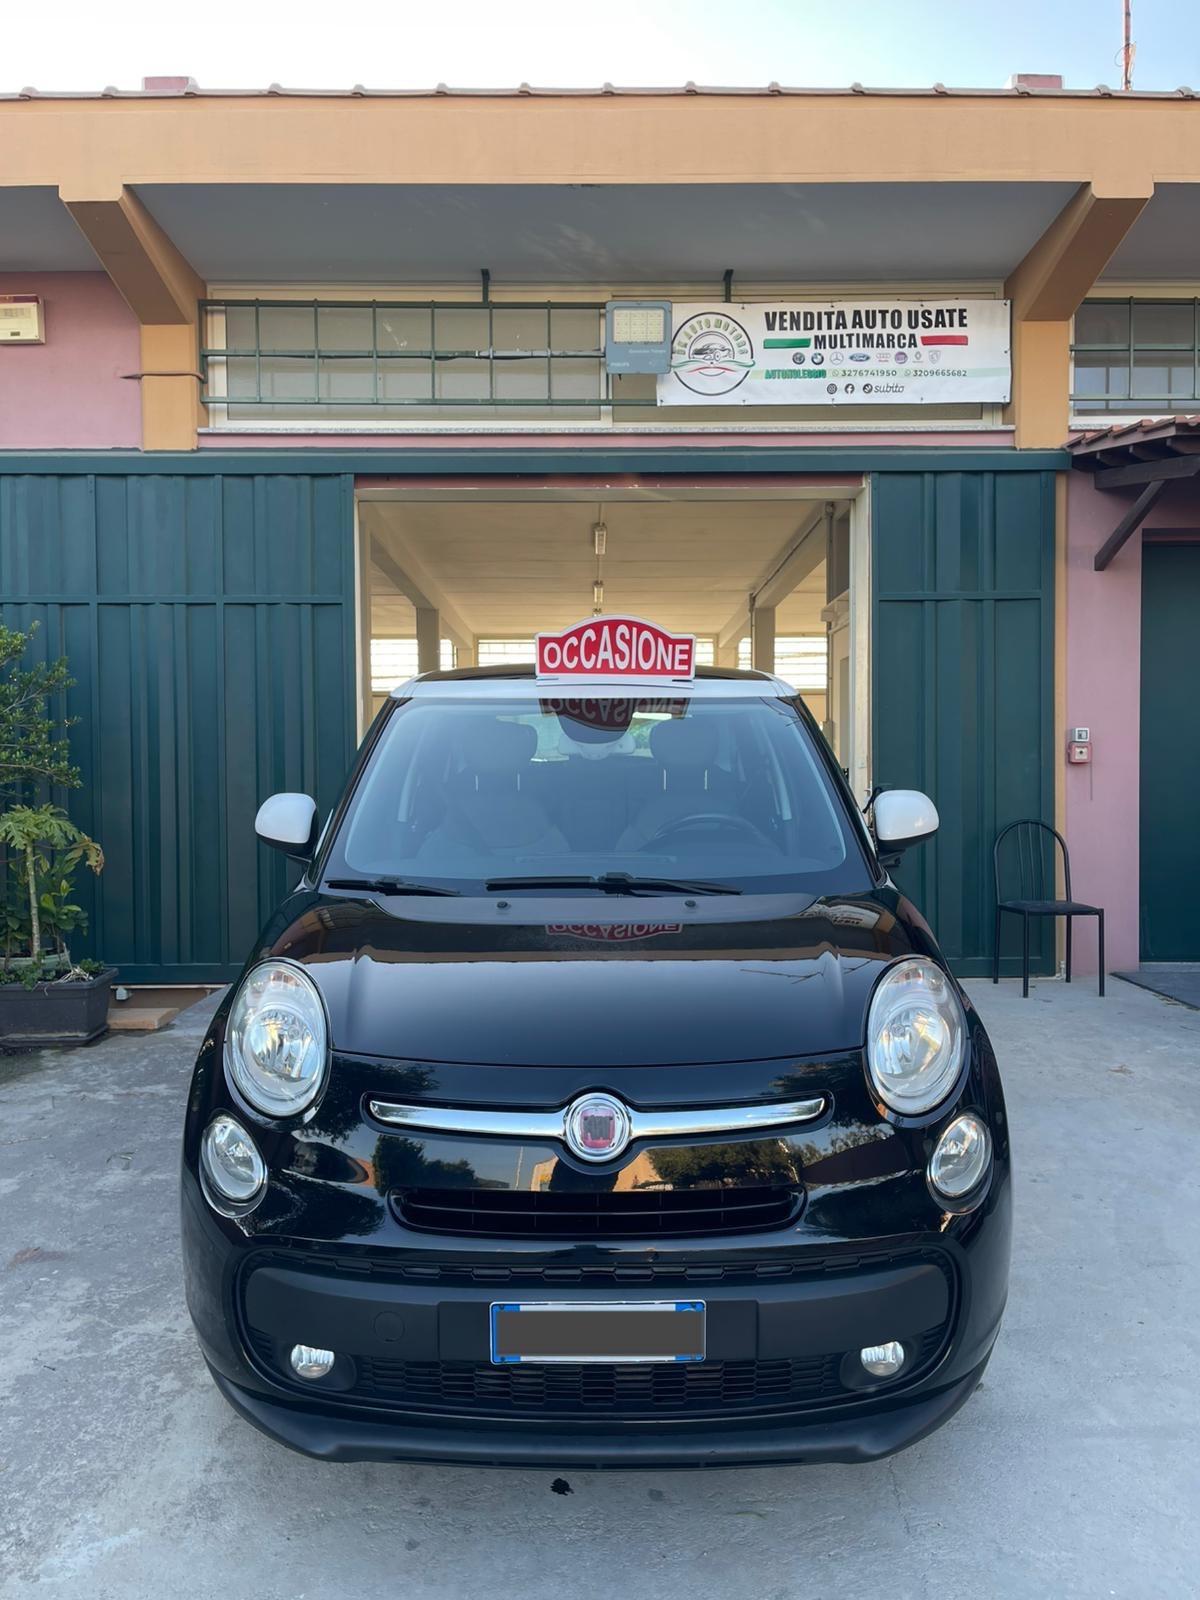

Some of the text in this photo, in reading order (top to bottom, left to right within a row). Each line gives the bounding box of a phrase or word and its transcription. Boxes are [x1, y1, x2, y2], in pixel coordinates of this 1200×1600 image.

[764, 307, 968, 331] VENDITA AUTO USATE
[684, 318, 711, 341] AUTO
[814, 333, 918, 349] MULTIMARCA
[841, 369, 897, 377] 3276741950
[912, 369, 968, 377] 3209665682
[873, 382, 905, 394] subito
[543, 624, 690, 671] OCCASIONE
